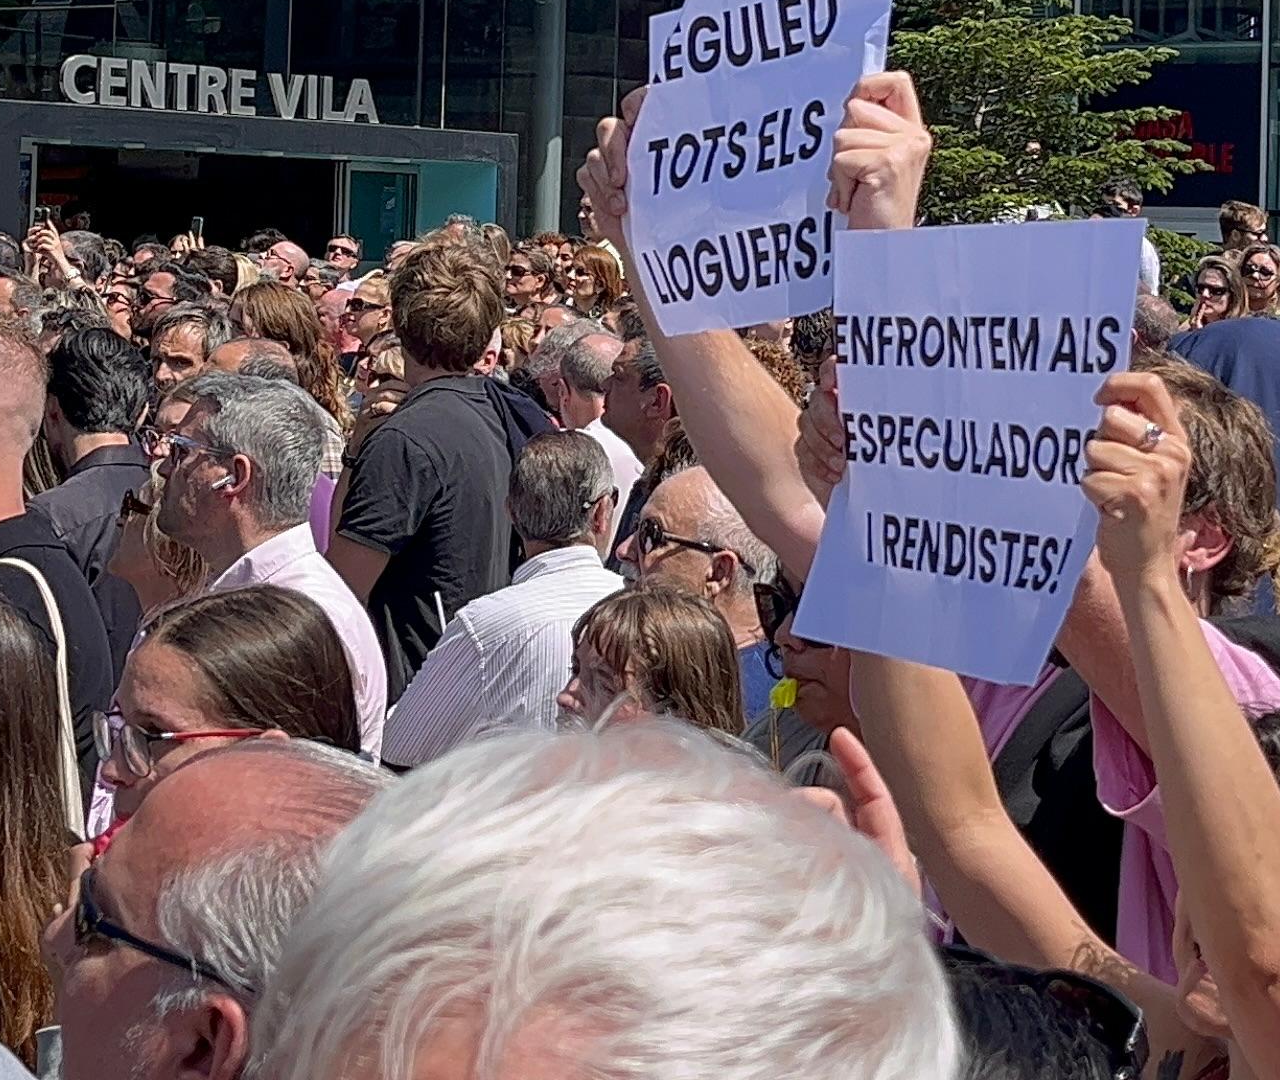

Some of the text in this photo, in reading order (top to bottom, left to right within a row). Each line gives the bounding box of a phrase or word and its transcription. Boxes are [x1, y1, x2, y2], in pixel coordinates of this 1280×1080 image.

[60, 54, 380, 124] CENTRE VILA
[649, 100, 825, 195] TOTS ELS
[834, 316, 1120, 373] ENFRONTEM ALS
[866, 511, 1073, 595] I RENDISTES!
